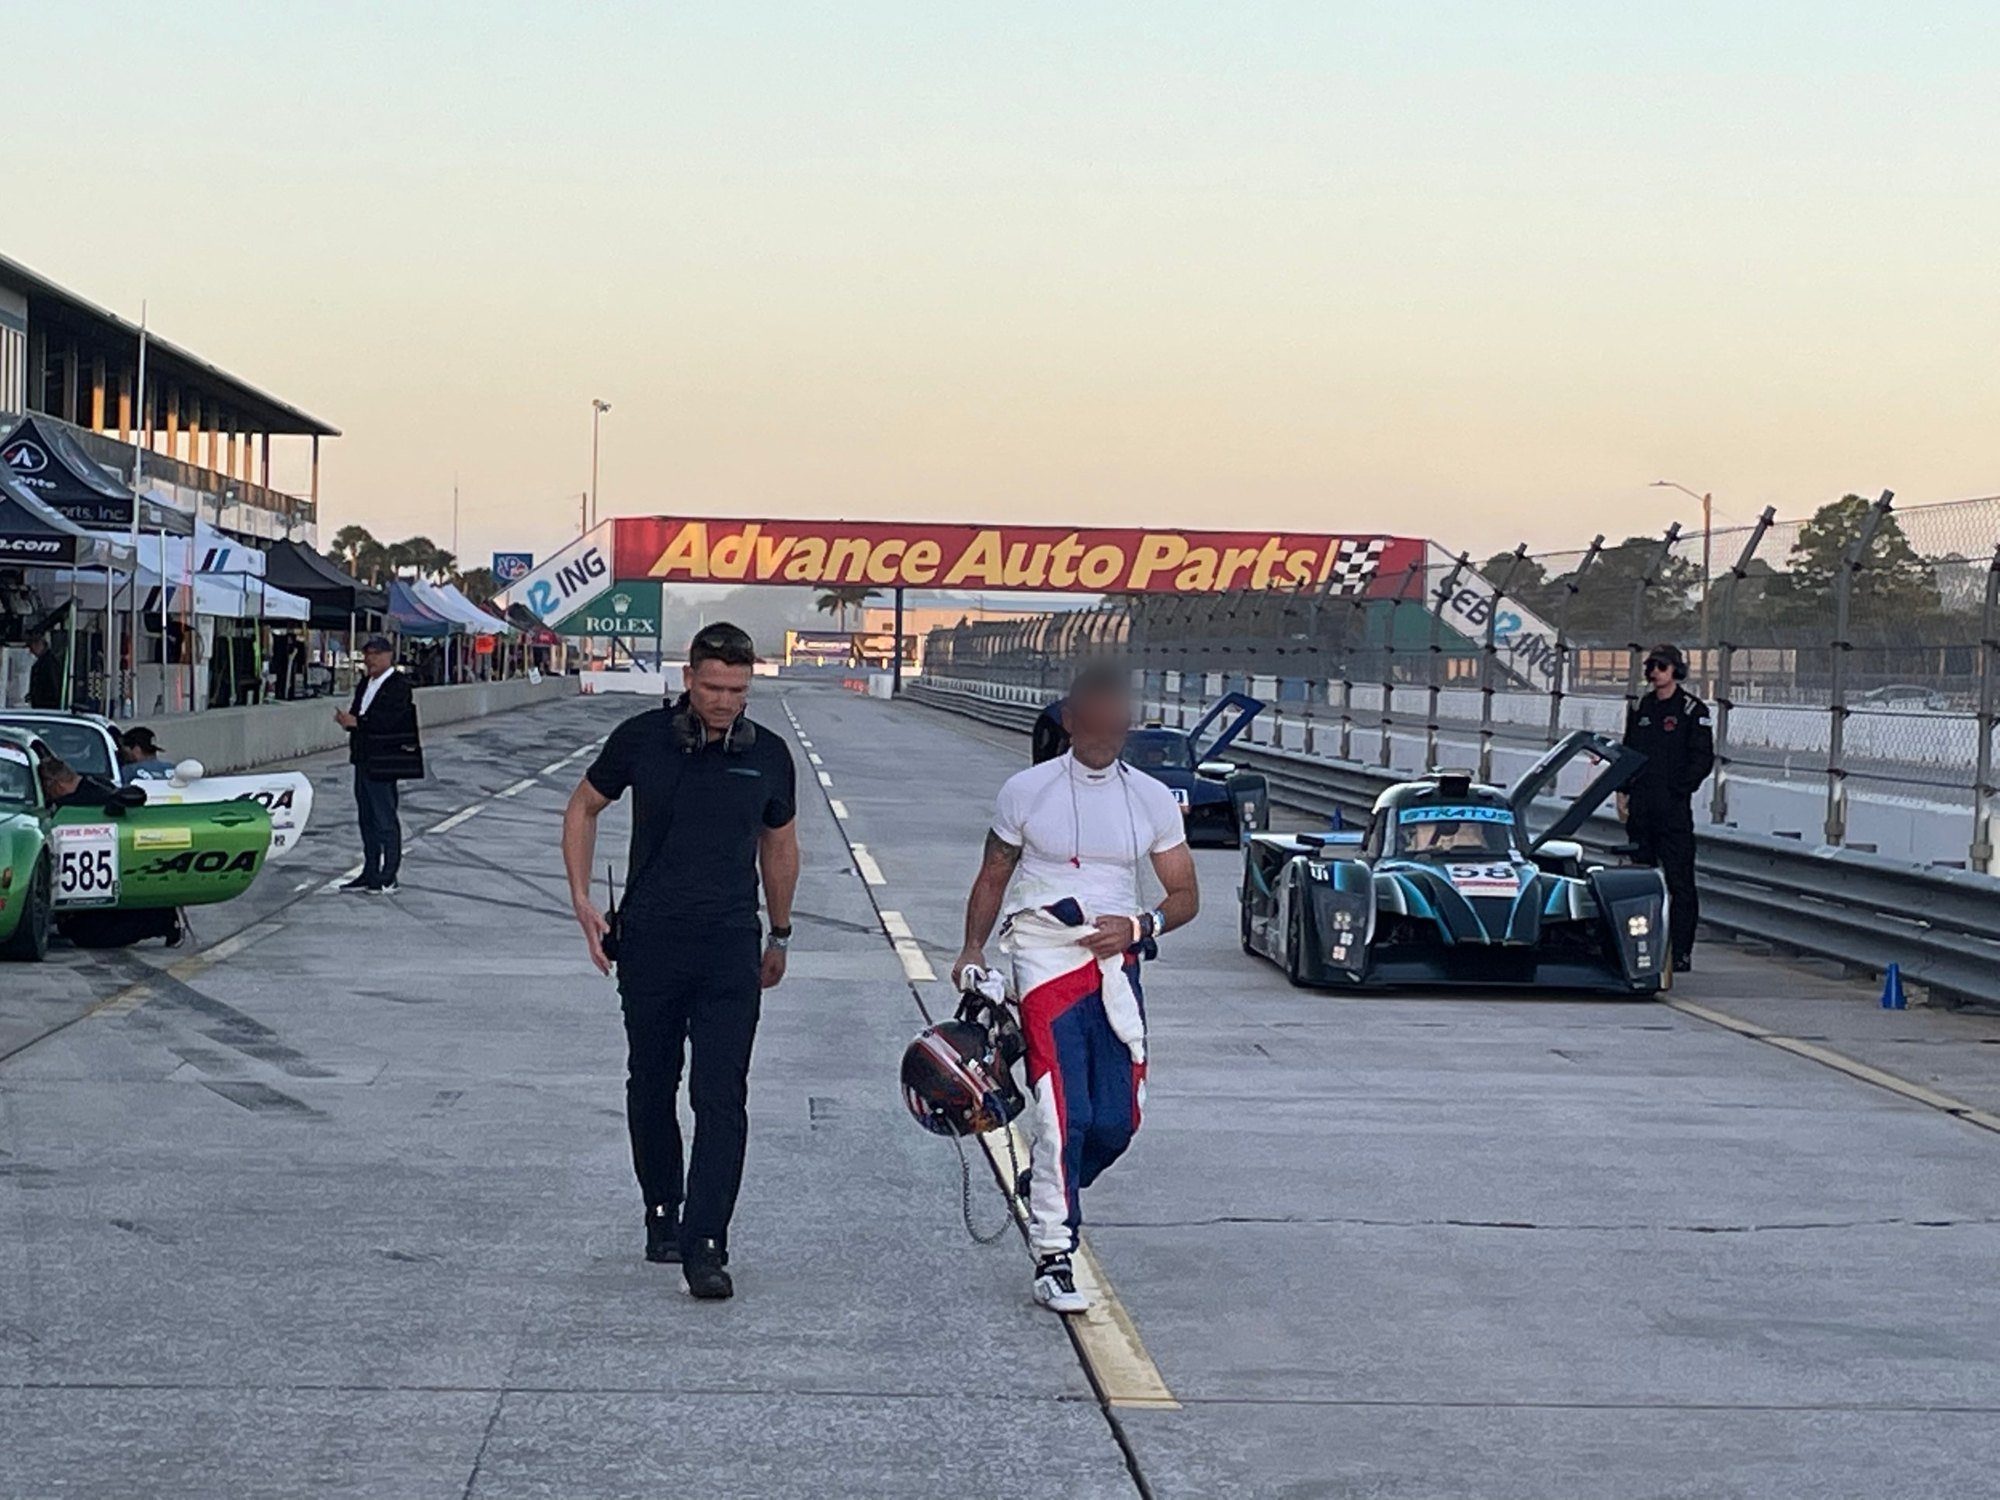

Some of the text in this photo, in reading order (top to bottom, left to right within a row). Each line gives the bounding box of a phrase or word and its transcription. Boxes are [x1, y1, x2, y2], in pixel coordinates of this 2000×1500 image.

[648, 522, 942, 584] Advance
[941, 530, 1126, 587] Auto
[586, 616, 655, 633] ROLEX
[61, 850, 112, 892] 585
[160, 850, 259, 874] AOA
